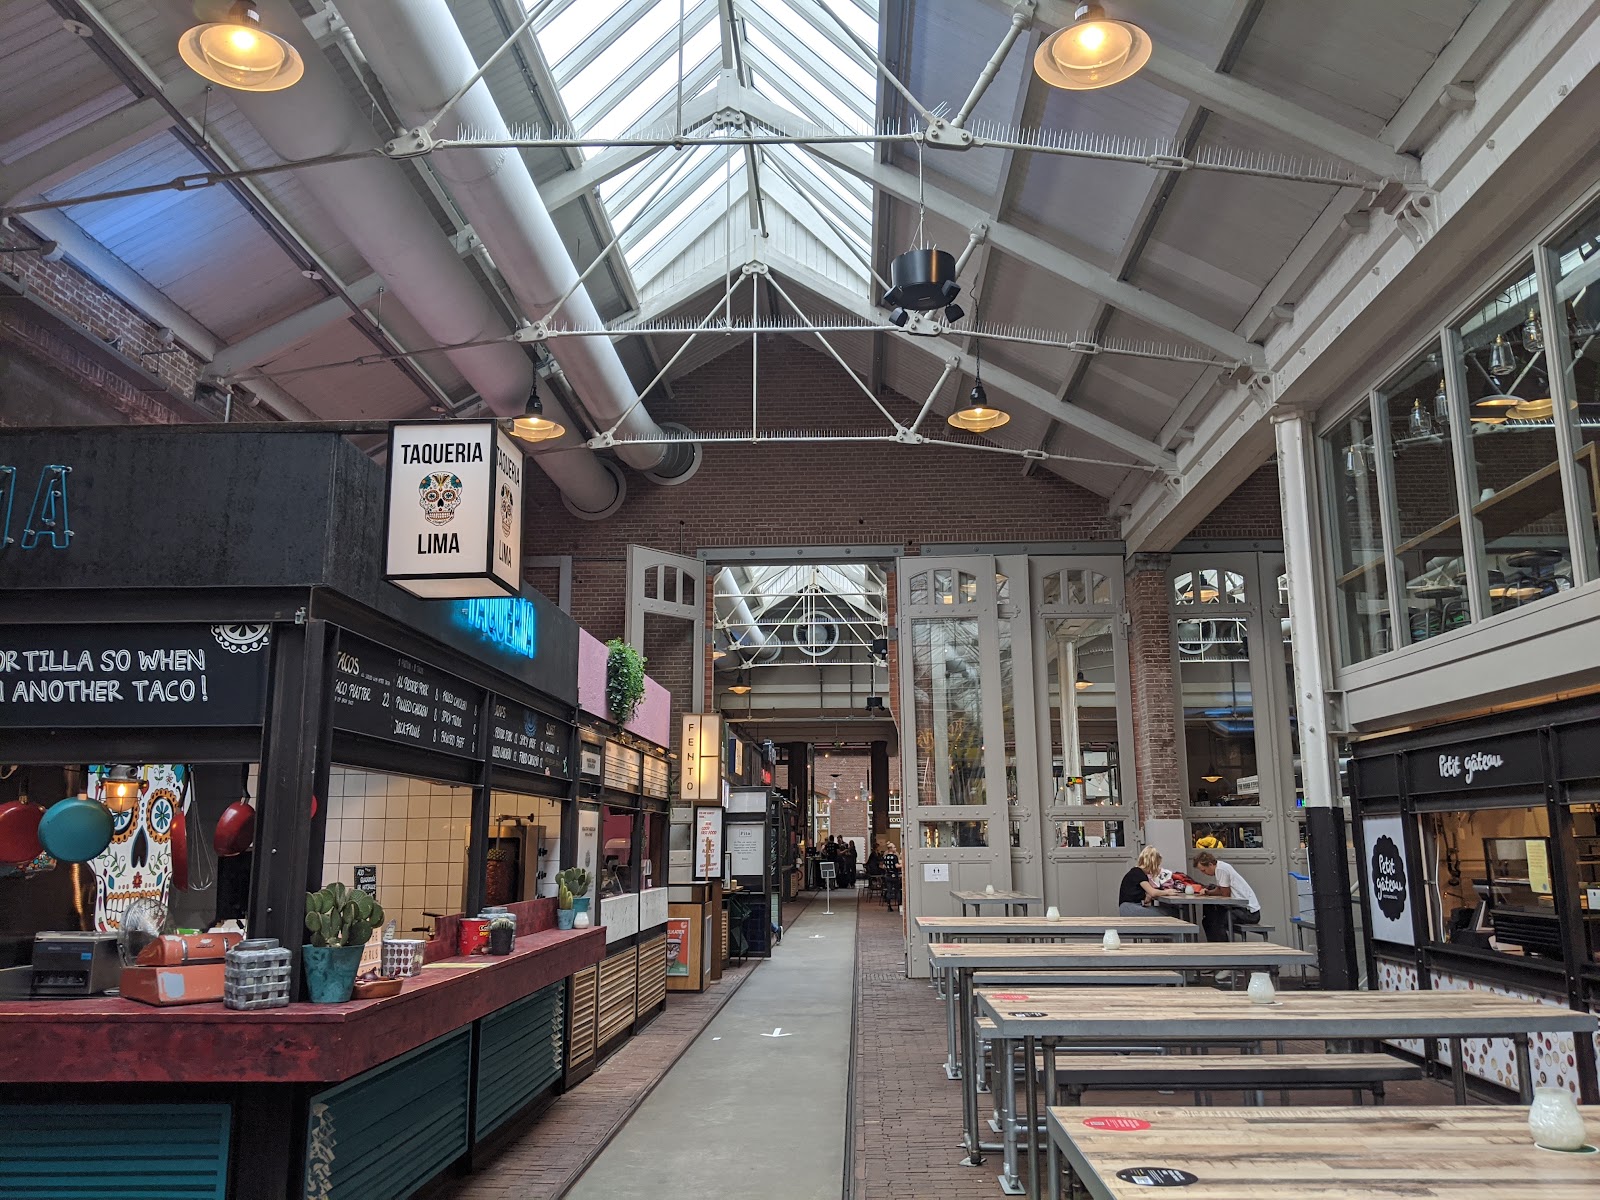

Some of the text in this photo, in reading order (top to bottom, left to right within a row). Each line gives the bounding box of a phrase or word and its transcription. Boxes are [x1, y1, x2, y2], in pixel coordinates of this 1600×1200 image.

[401, 442, 484, 465] TAQUERIA
[417, 533, 460, 555] LIMA
[498, 539, 512, 568] LIMA
[100, 649, 131, 672] SO
[138, 649, 206, 672] WHEN
[12, 679, 124, 703] ANOTHER
[686, 723, 695, 791] FENTO
[1439, 751, 1504, 784] Petit gâteau
[1379, 854, 1395, 876] Petit
[1376, 876, 1403, 900] gâteau
